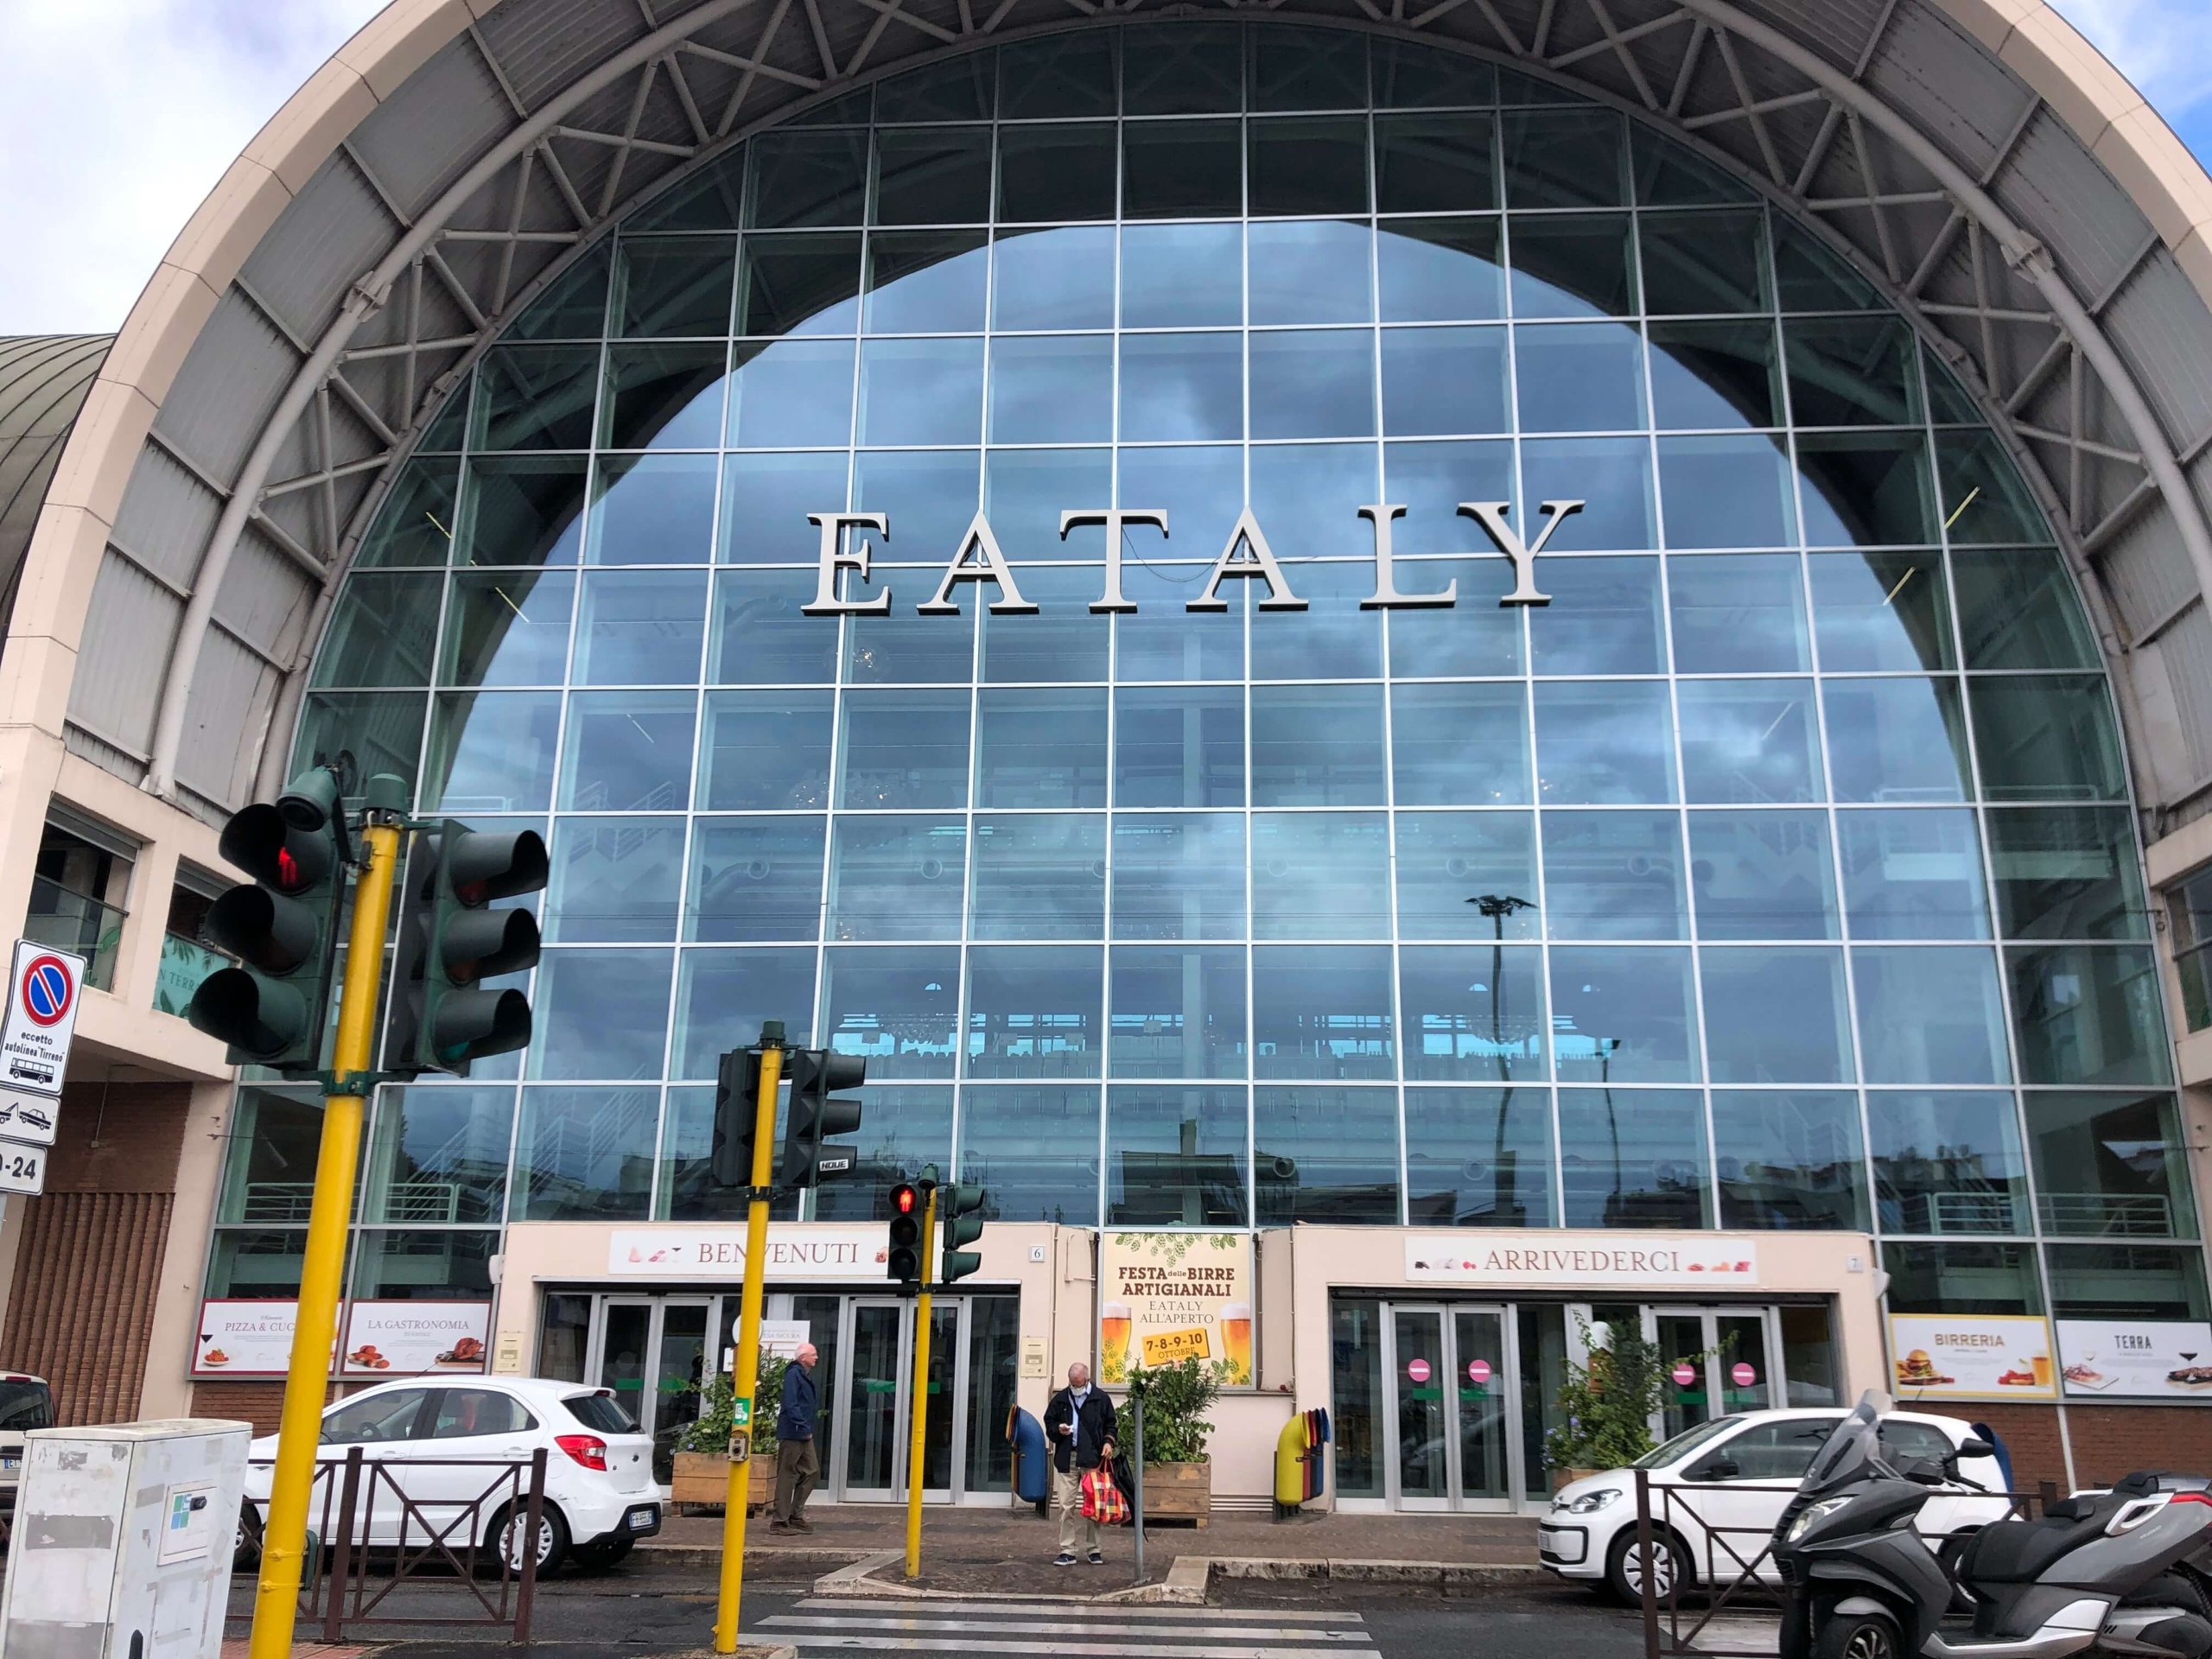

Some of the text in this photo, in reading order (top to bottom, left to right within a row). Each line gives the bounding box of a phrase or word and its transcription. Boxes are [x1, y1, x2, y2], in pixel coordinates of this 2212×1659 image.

[800, 499, 1586, 616] EATALY
[21, 1032, 54, 1046] eccetto
[4, 1042, 37, 1057] autolinea
[1033, 1248, 1041, 1259] 6
[1484, 1249, 1681, 1273] ARRIVEDERCI
[1118, 1267, 1167, 1281] FESTA
[1187, 1267, 1236, 1281] BIRRE
[1122, 1282, 1231, 1297] ARTIGIANALI
[1149, 1300, 1204, 1311] EATALY
[367, 1320, 470, 1331] LA GASTRONOMIA
[1140, 1313, 1214, 1325] ALL'APERTO
[225, 1322, 257, 1332] PIZZA
[258, 1322, 266, 1332] &
[1935, 1333, 2005, 1347] BIRRERIA
[2114, 1335, 2153, 1350] TERRA
[1158, 1346, 1196, 1359] OTTOBRE
